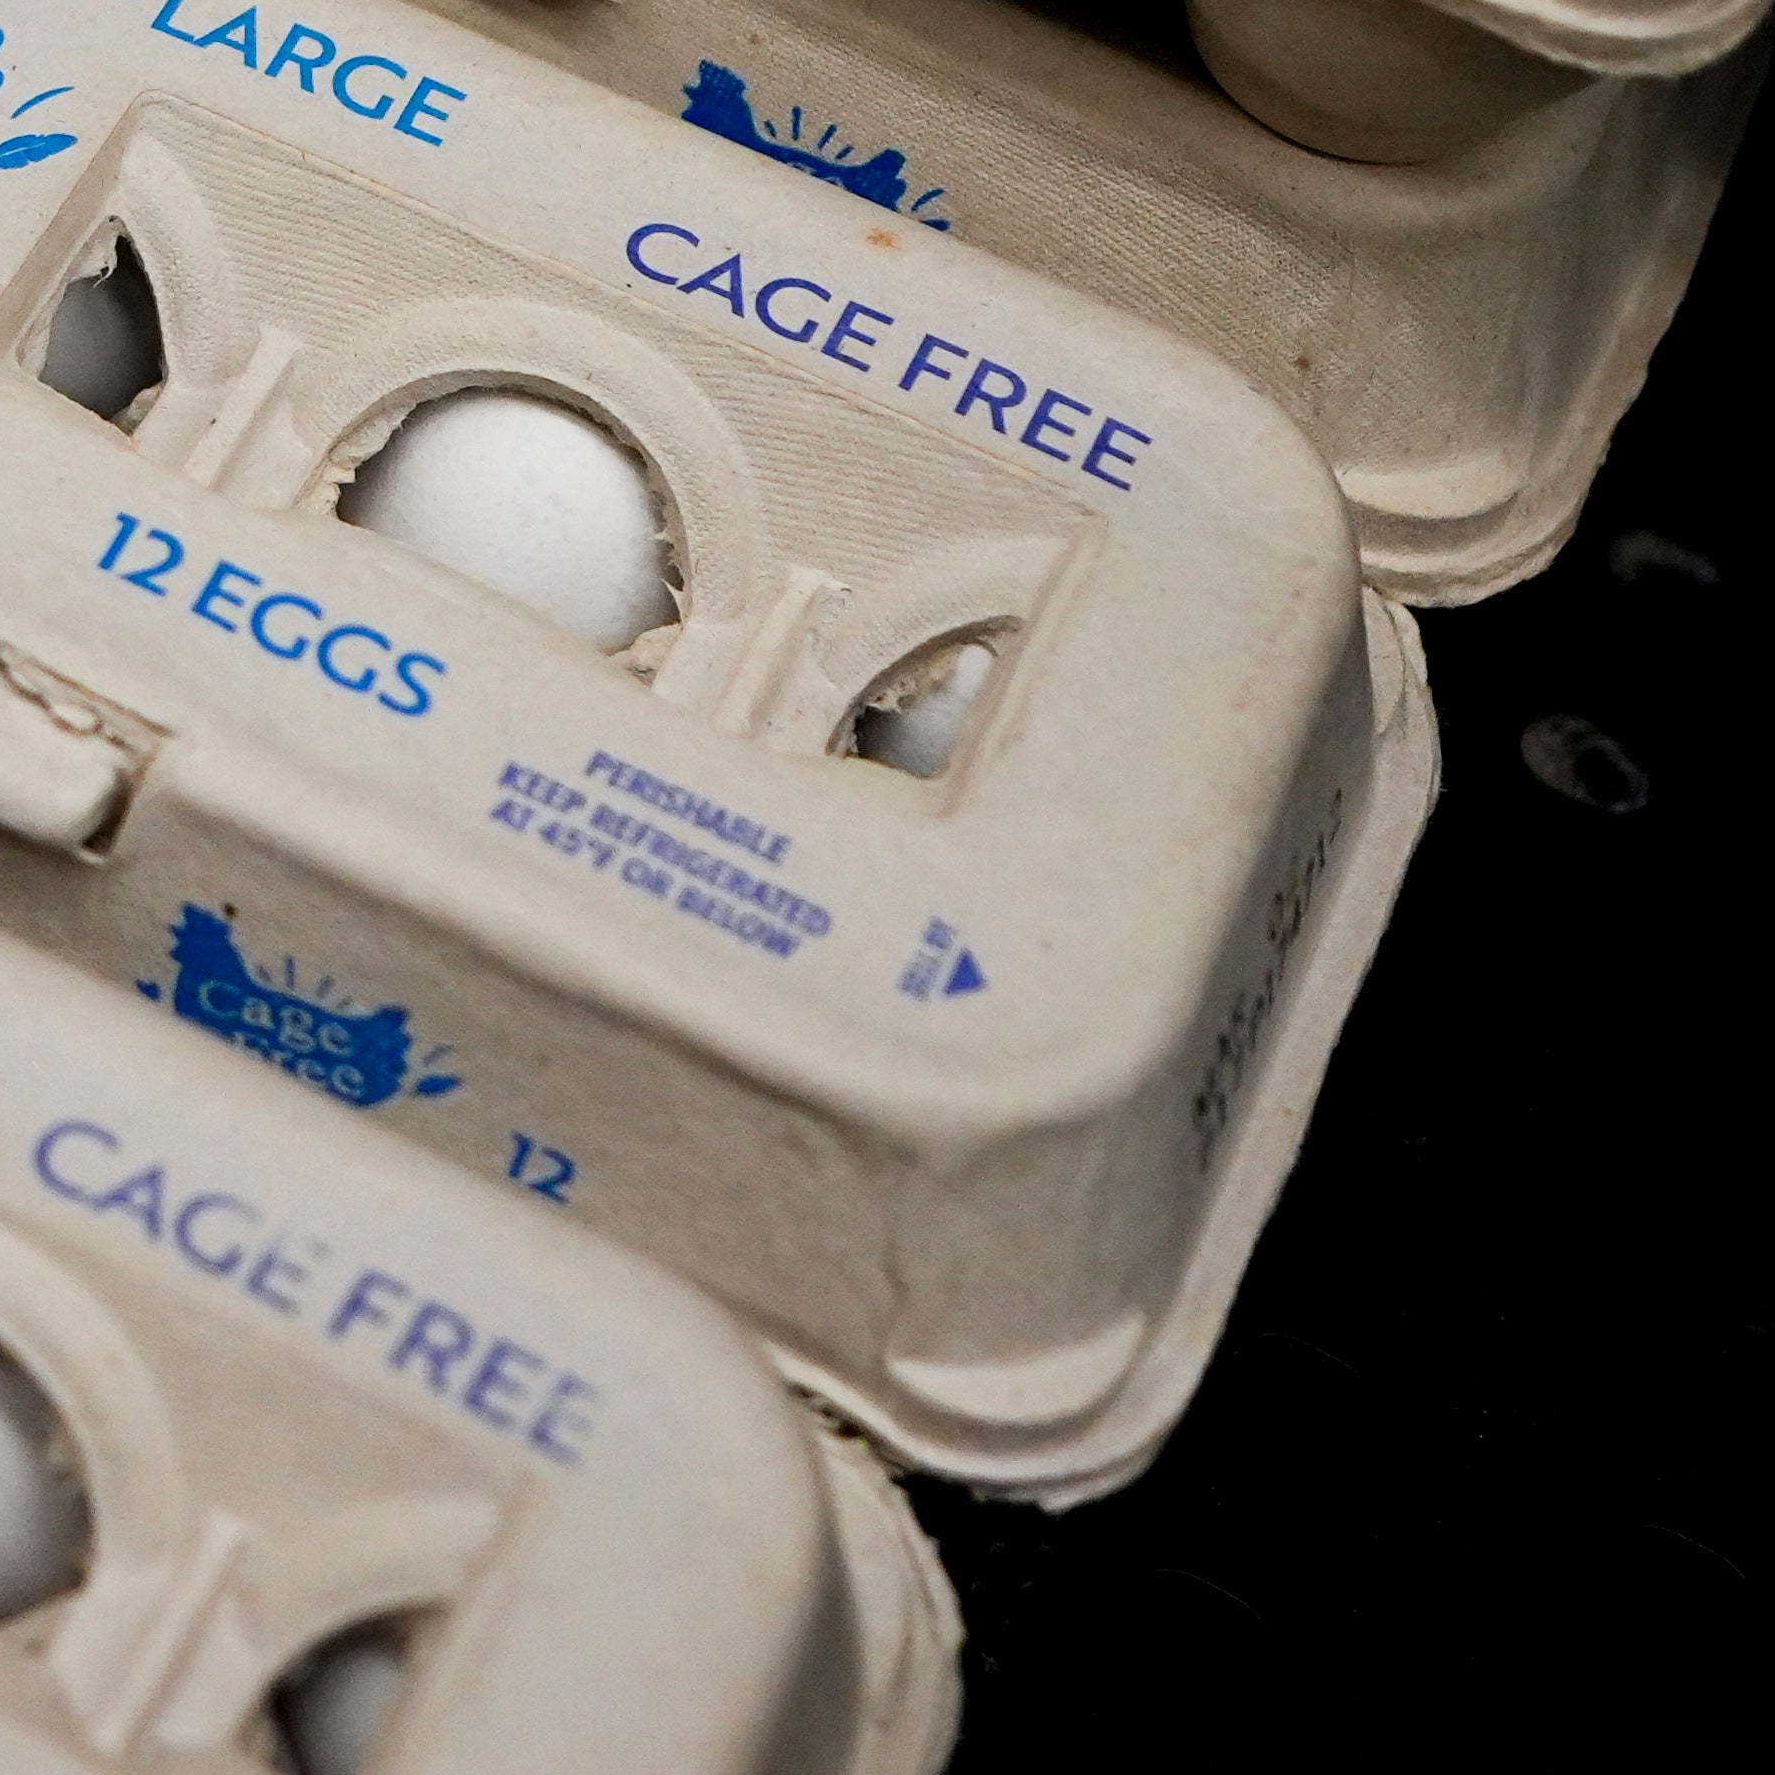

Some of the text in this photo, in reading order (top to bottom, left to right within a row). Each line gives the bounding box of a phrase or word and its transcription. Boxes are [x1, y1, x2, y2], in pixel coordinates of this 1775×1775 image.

[623, 222, 1156, 492] CAGE FREE
[94, 511, 448, 720] 12 EGGS
[197, 977, 356, 1057] Cage
[506, 1129, 578, 1207] 12
[30, 1119, 607, 1468] CAGE FREE
